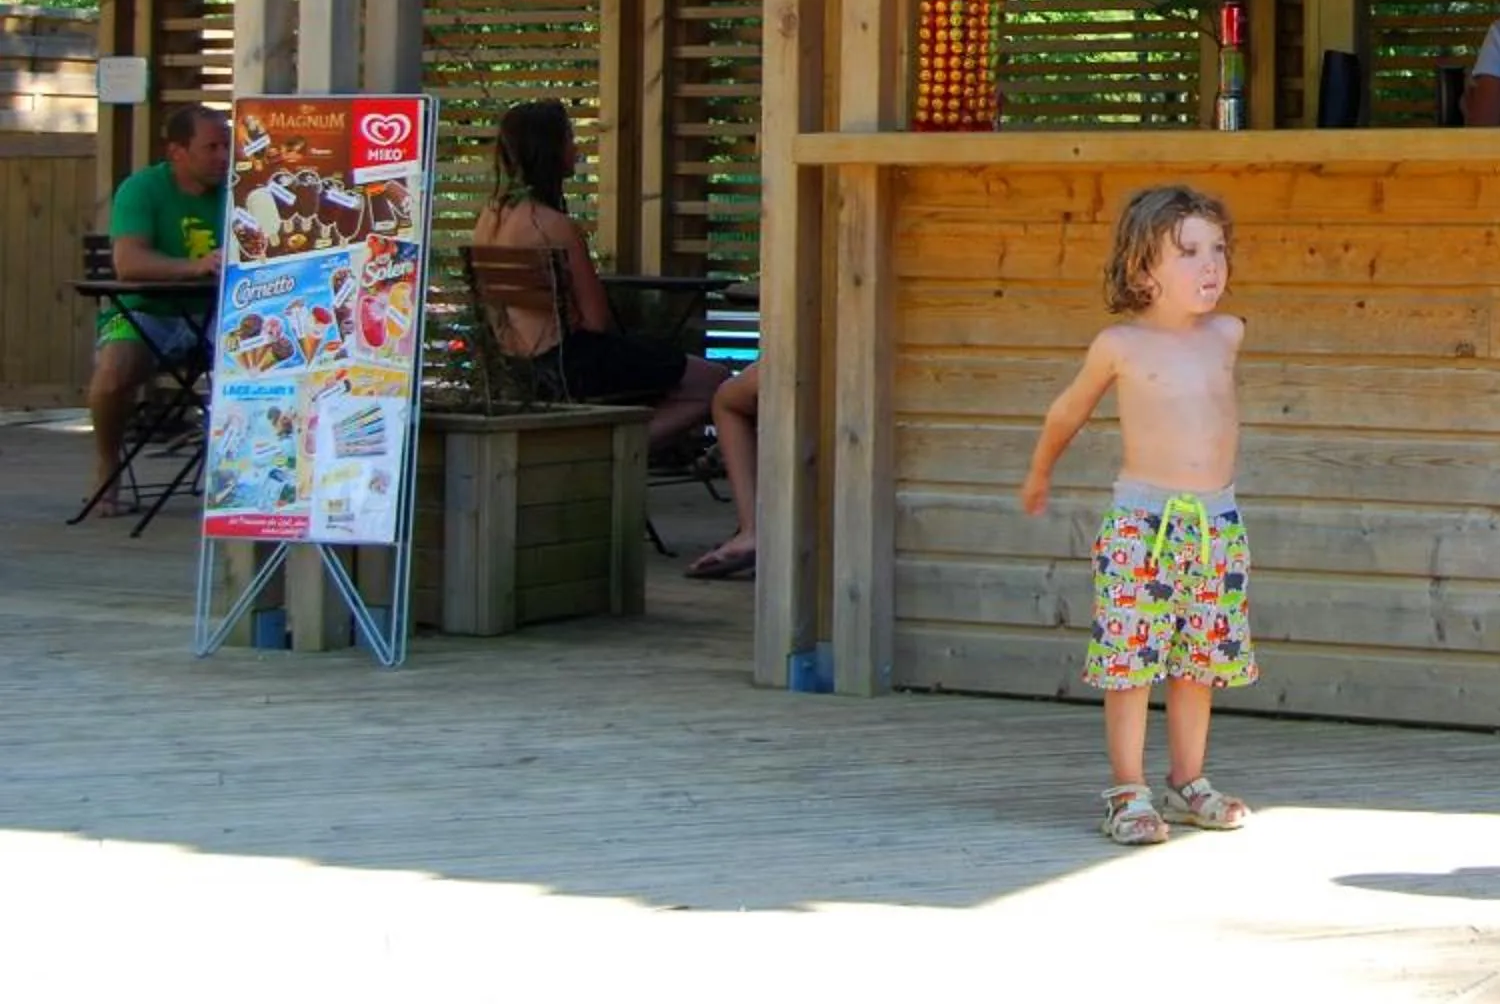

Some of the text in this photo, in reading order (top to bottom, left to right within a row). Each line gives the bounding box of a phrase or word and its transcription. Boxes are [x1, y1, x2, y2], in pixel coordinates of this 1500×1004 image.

[269, 111, 346, 130] MAGNUM
[366, 147, 404, 162] MIKO
[231, 274, 297, 310] Cornetto
